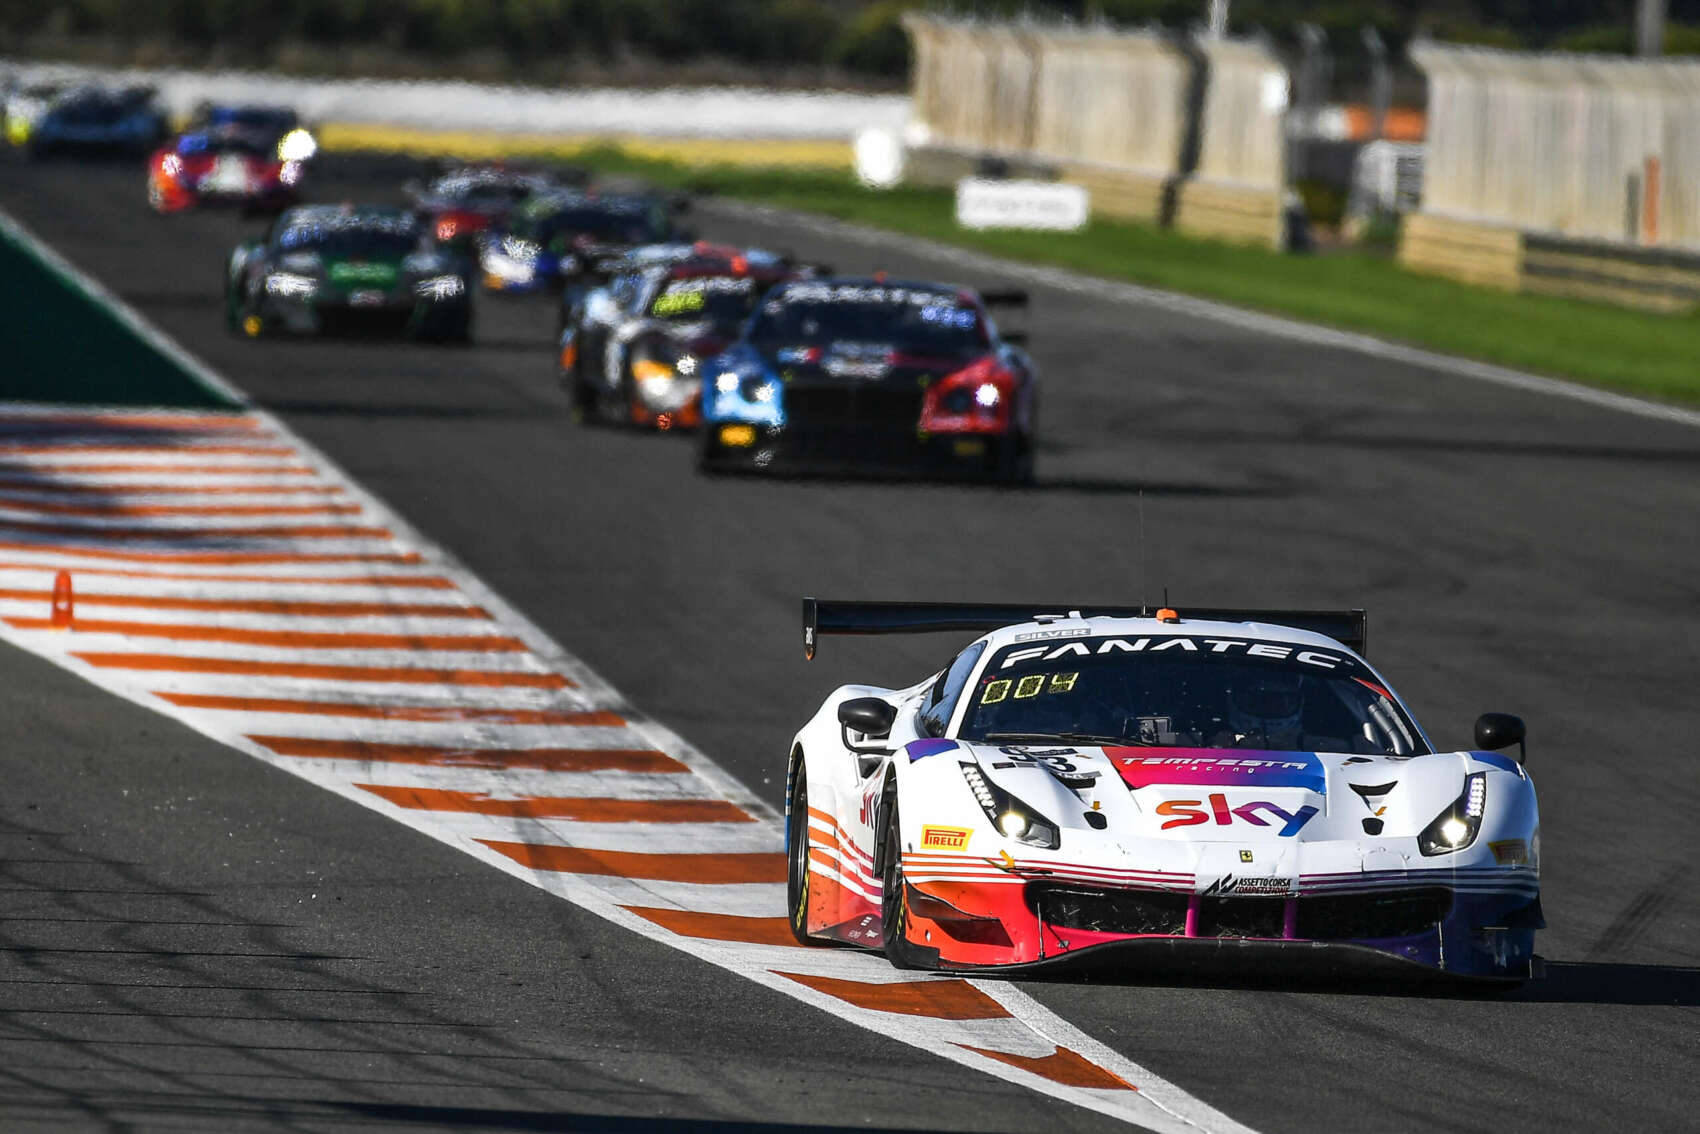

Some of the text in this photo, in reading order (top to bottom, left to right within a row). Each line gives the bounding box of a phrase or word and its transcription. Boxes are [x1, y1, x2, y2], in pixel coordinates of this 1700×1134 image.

[1019, 629, 1088, 640] SILVER
[1001, 638, 1342, 669] FANATEC
[980, 672, 1080, 705] 004
[1121, 757, 1308, 770] TEMPESTA
[1175, 765, 1256, 775] racing
[1155, 793, 1320, 837] sky
[924, 829, 967, 847] PIRELLI
[1238, 878, 1291, 887] ASSETTO CORSA
[1235, 886, 1290, 895] COMPETIZIONE
